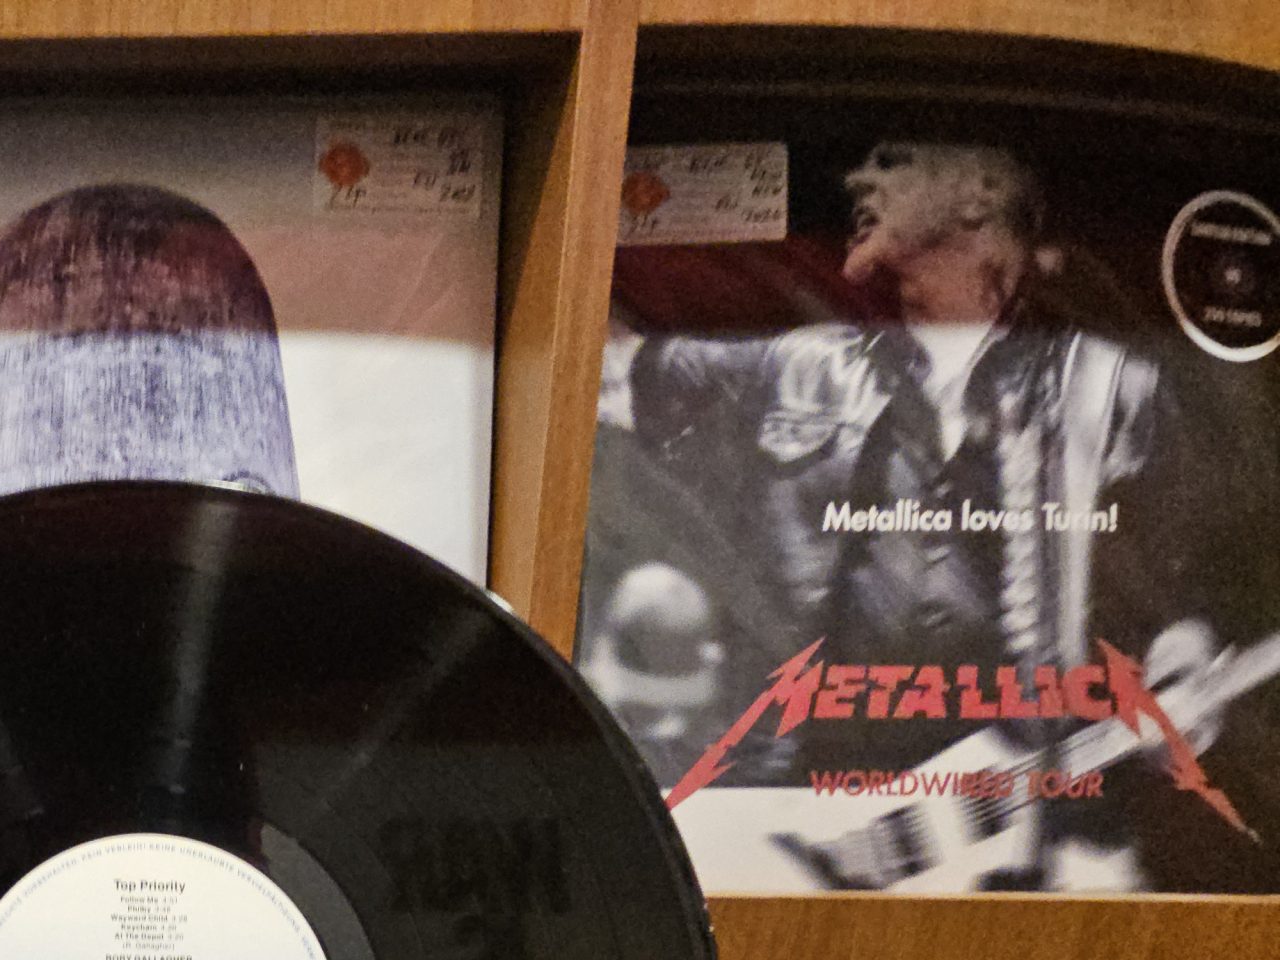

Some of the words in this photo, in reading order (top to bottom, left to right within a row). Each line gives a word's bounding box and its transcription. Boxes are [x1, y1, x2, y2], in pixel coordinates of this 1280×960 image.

[822, 498, 953, 532] Metallica
[960, 498, 1034, 532] loves
[1040, 501, 1119, 533] Turin!
[666, 636, 1260, 845] METALLICA
[810, 769, 1015, 799] WORLDWIRED
[1027, 770, 1105, 799] TOUR
[114, 879, 136, 892] Top
[140, 879, 186, 894] Priority
[110, 914, 147, 923] Wayward
